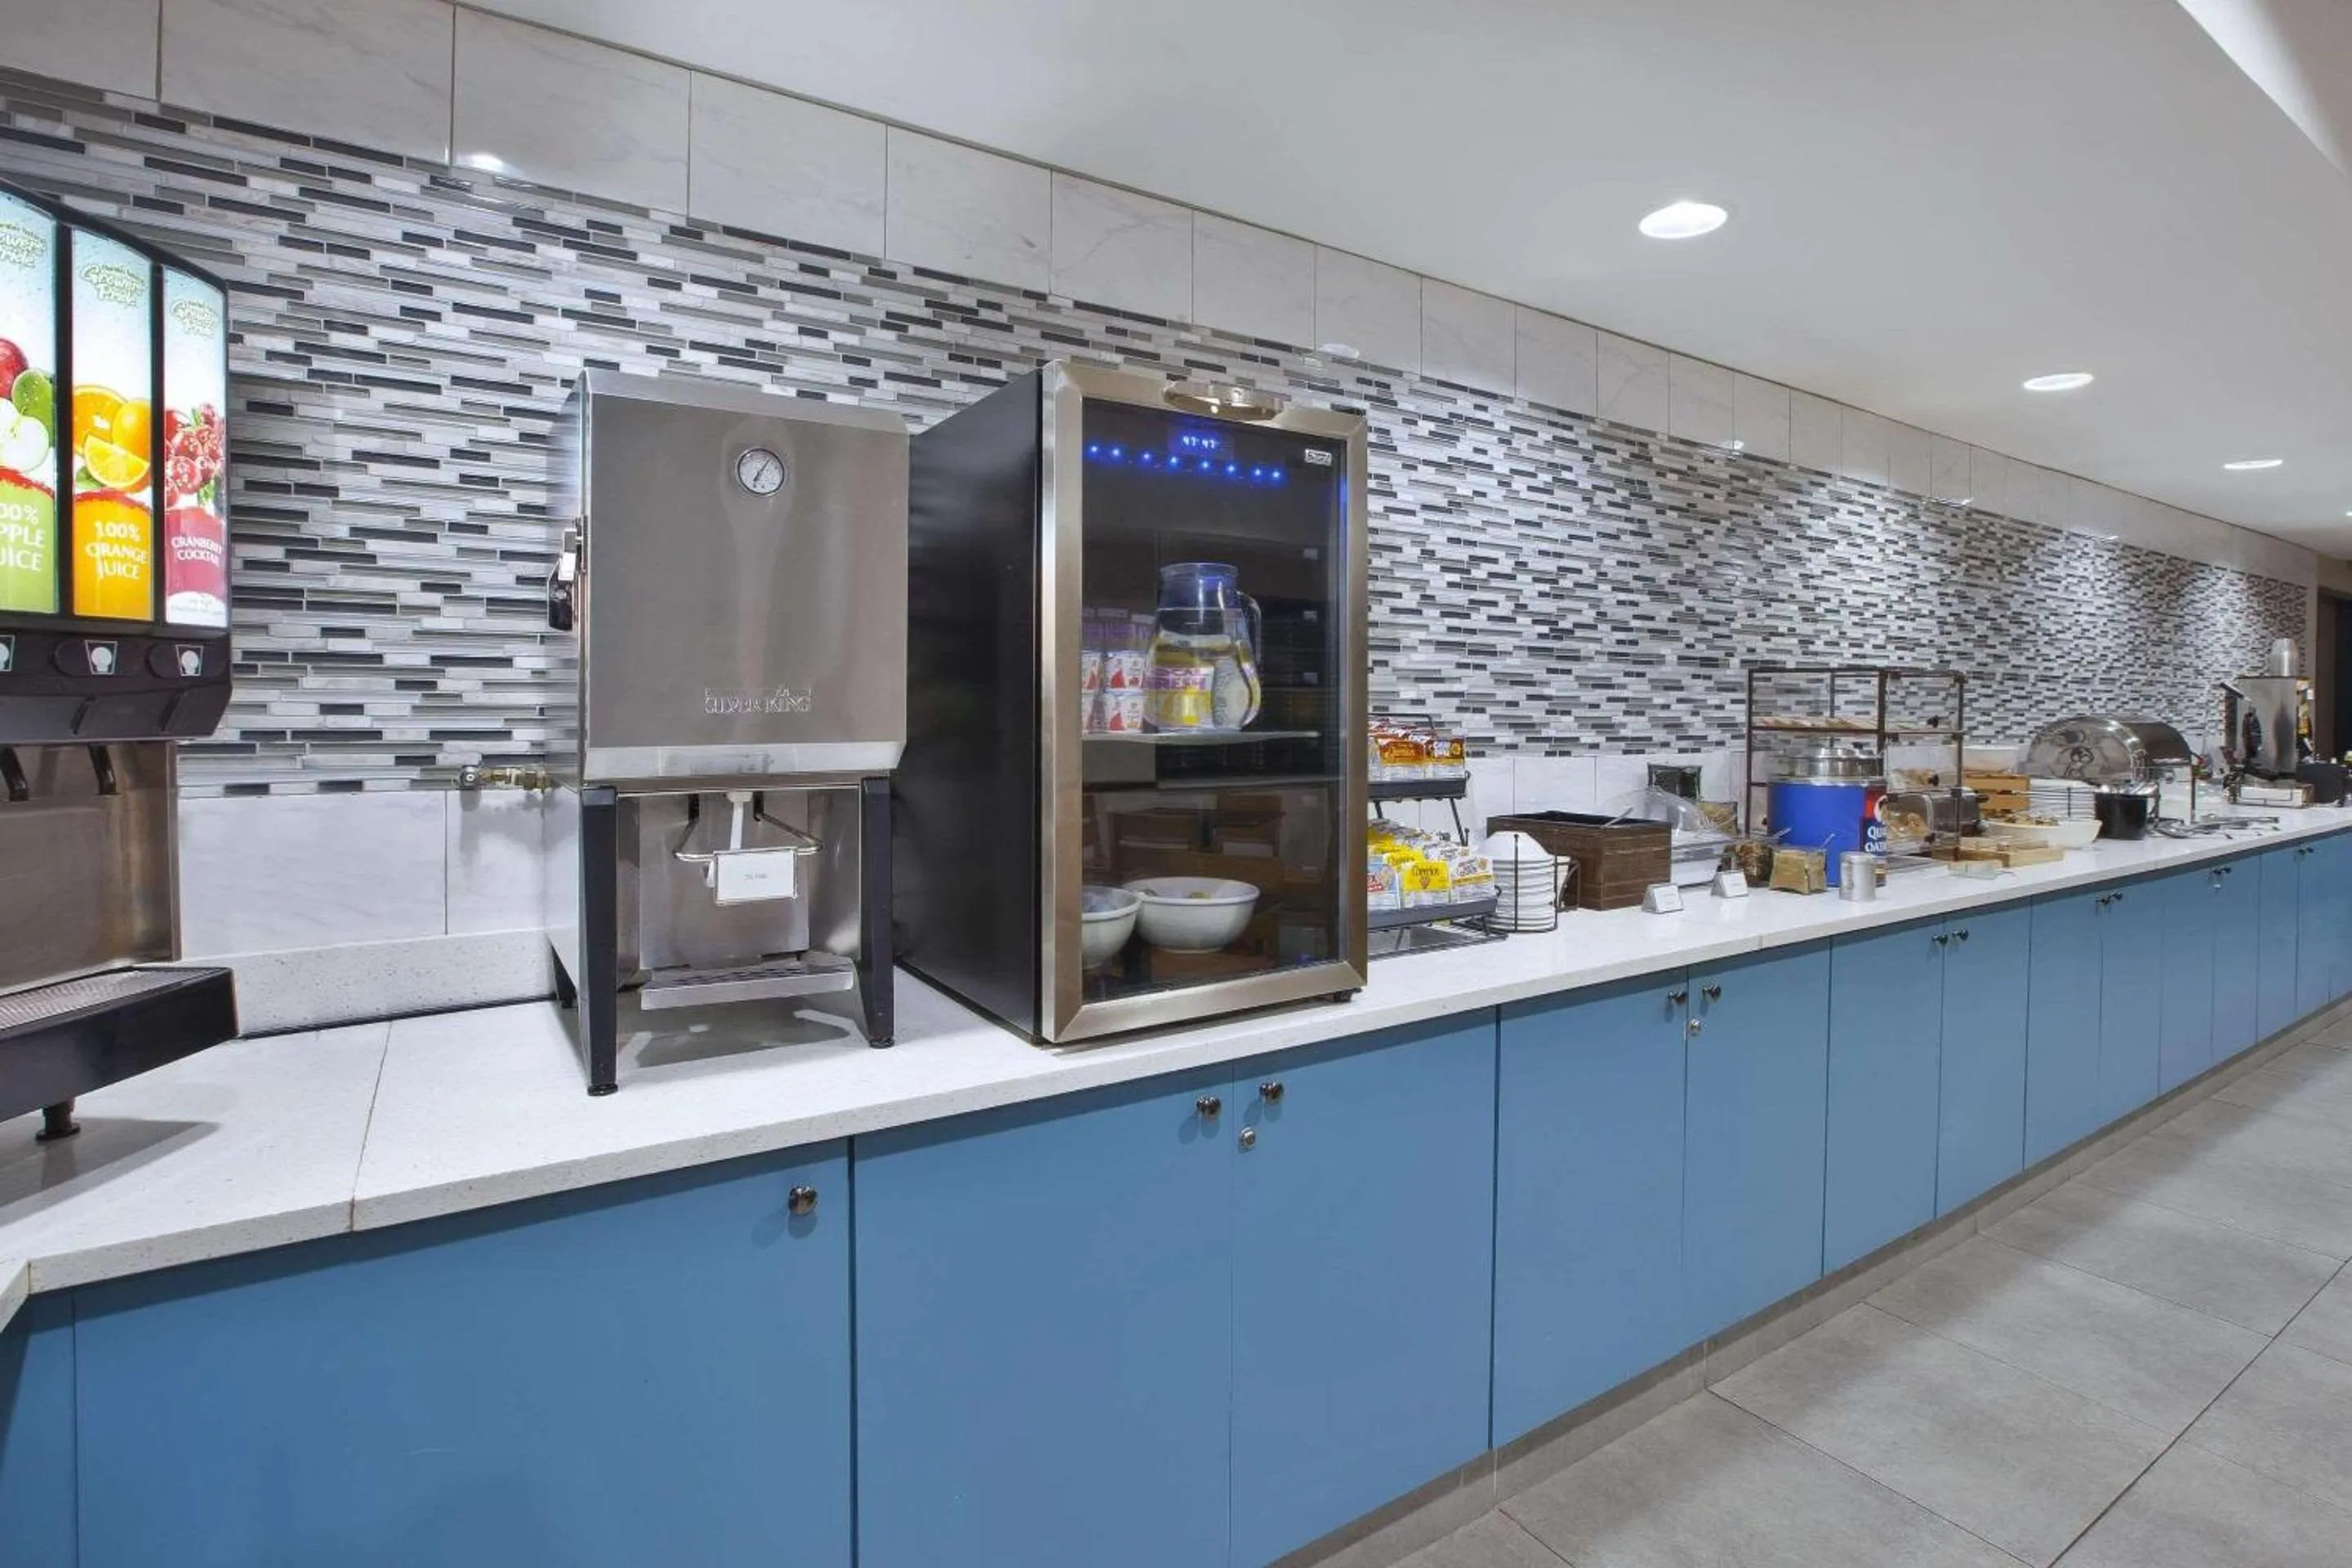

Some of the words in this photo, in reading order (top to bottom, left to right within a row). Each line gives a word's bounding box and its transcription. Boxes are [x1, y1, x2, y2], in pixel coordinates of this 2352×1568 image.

[0, 502, 38, 525] 00%
[0, 523, 46, 547] PPLE
[94, 520, 140, 542] 100%
[85, 542, 148, 564] ORANGE
[96, 556, 140, 579] JUICE
